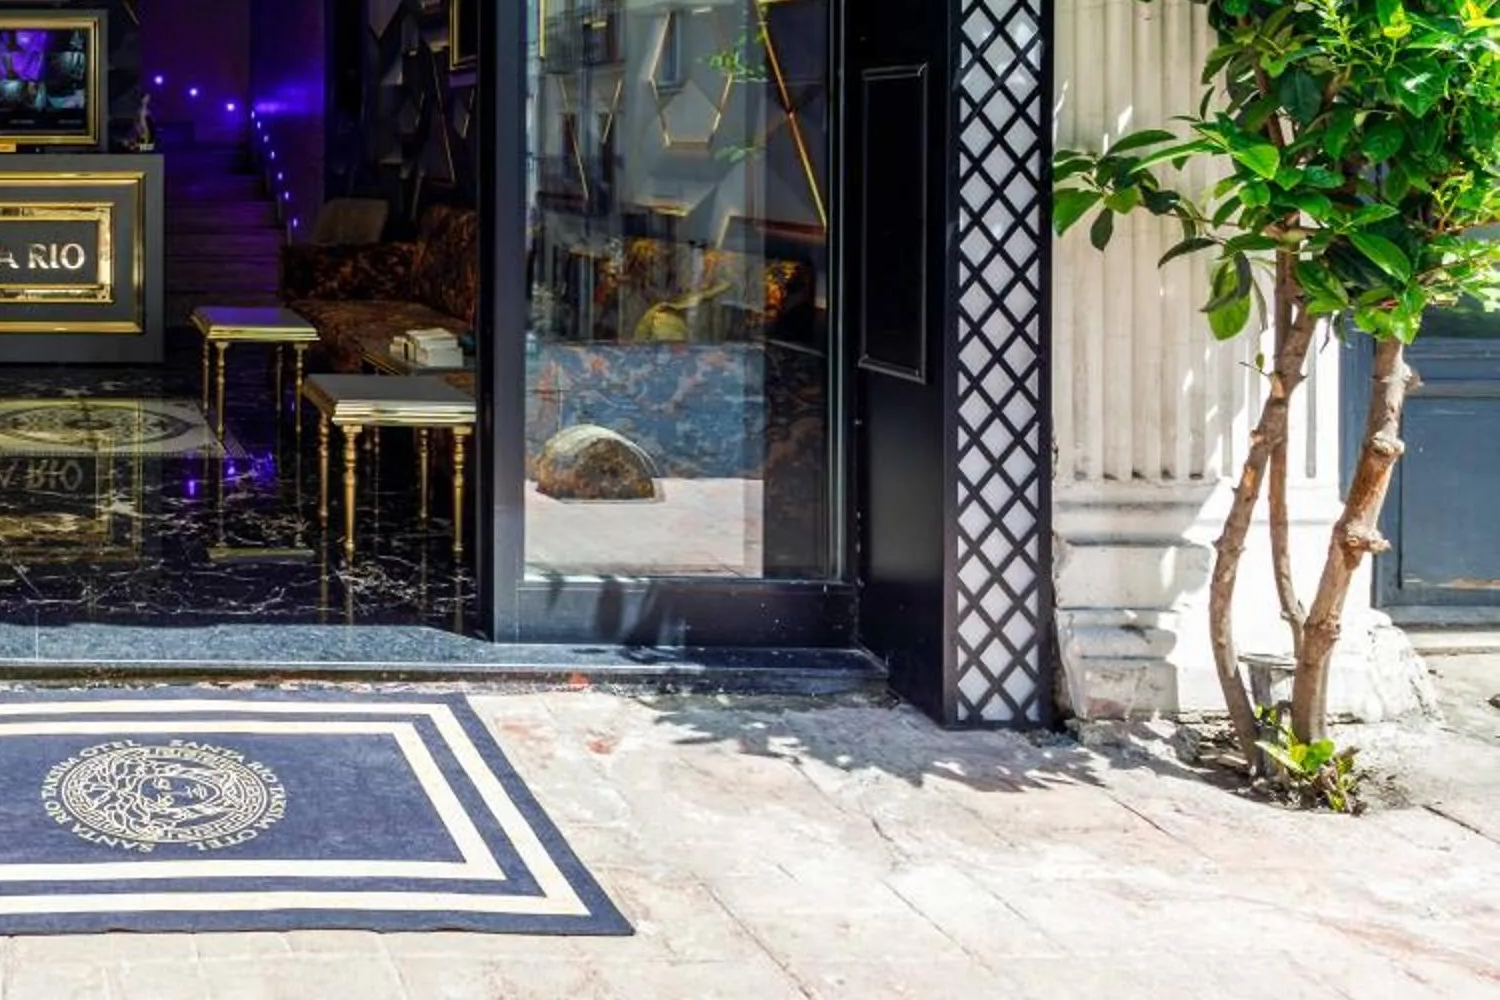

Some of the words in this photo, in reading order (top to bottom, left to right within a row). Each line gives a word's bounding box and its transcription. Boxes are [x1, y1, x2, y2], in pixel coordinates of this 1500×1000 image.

[27, 241, 86, 270] RIO
[79, 739, 142, 758] OTEL
[169, 739, 245, 763] SANTA
[246, 760, 279, 784] RIO
[43, 800, 74, 825] RIO
[71, 821, 156, 853] SANTA
[186, 828, 259, 851] OTEL
